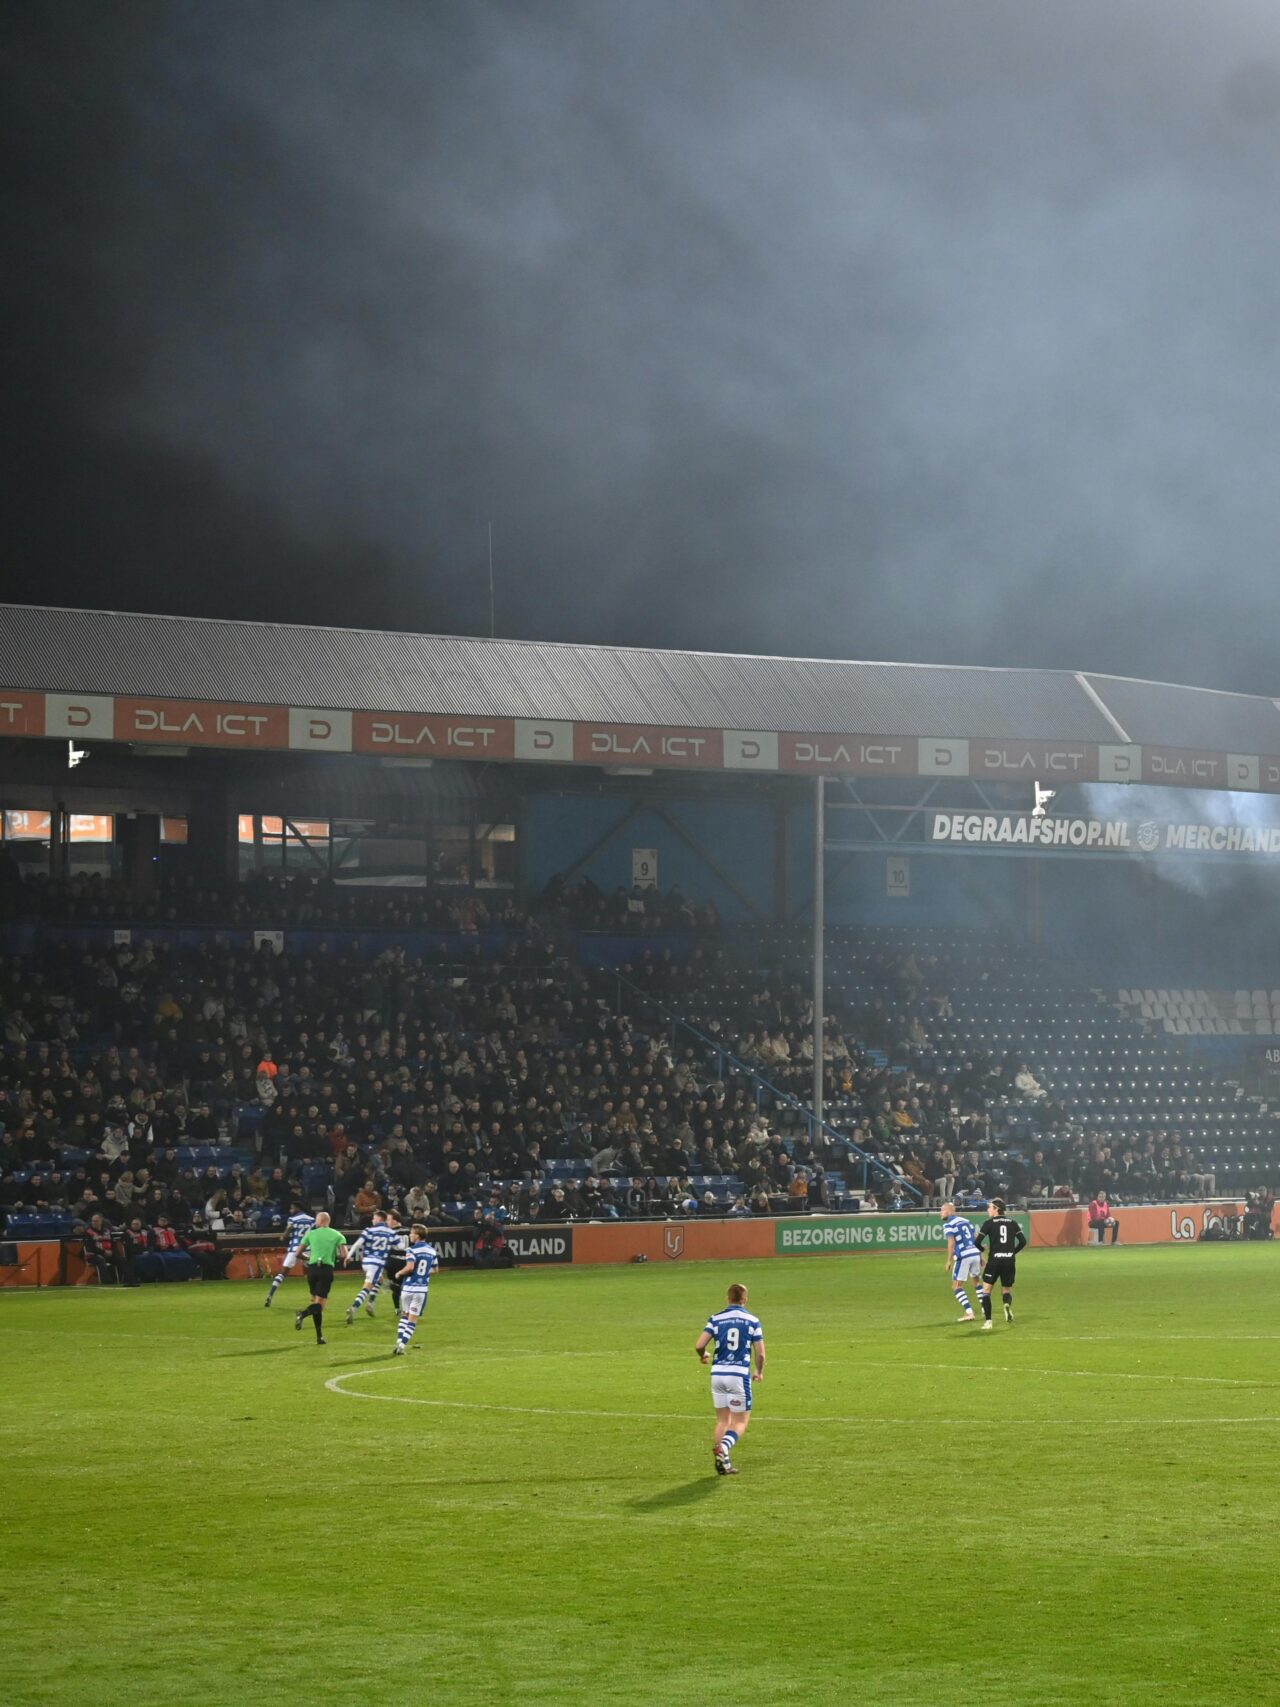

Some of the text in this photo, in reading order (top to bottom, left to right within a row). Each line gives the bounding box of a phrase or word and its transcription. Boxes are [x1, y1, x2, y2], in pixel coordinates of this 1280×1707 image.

[68, 706, 91, 726] D
[135, 710, 268, 735] DLA ICT
[309, 720, 332, 739] D
[372, 723, 495, 746] DLA ICT
[534, 730, 554, 749] D
[591, 733, 706, 757] DLA ICT
[741, 741, 760, 759] D
[795, 743, 901, 764] DLA ICT
[935, 748, 952, 766] D
[985, 751, 1083, 770] DLA ICT
[1114, 755, 1130, 772] D
[1151, 755, 1218, 776] DLA ICT
[1238, 764, 1249, 780] D
[932, 814, 1131, 847] DEGRAAFSHOP.NL
[640, 861, 649, 876] 9
[892, 870, 905, 884] 10
[298, 1224, 312, 1237] 22
[782, 1226, 873, 1246] BEZORGING
[876, 1226, 886, 1242] &
[961, 1225, 971, 1239] 3
[999, 1225, 1007, 1244] 9
[371, 1236, 388, 1250] 23
[429, 1238, 565, 1259] AN NRLAND
[416, 1259, 427, 1276] 8
[727, 1327, 740, 1351] 9
